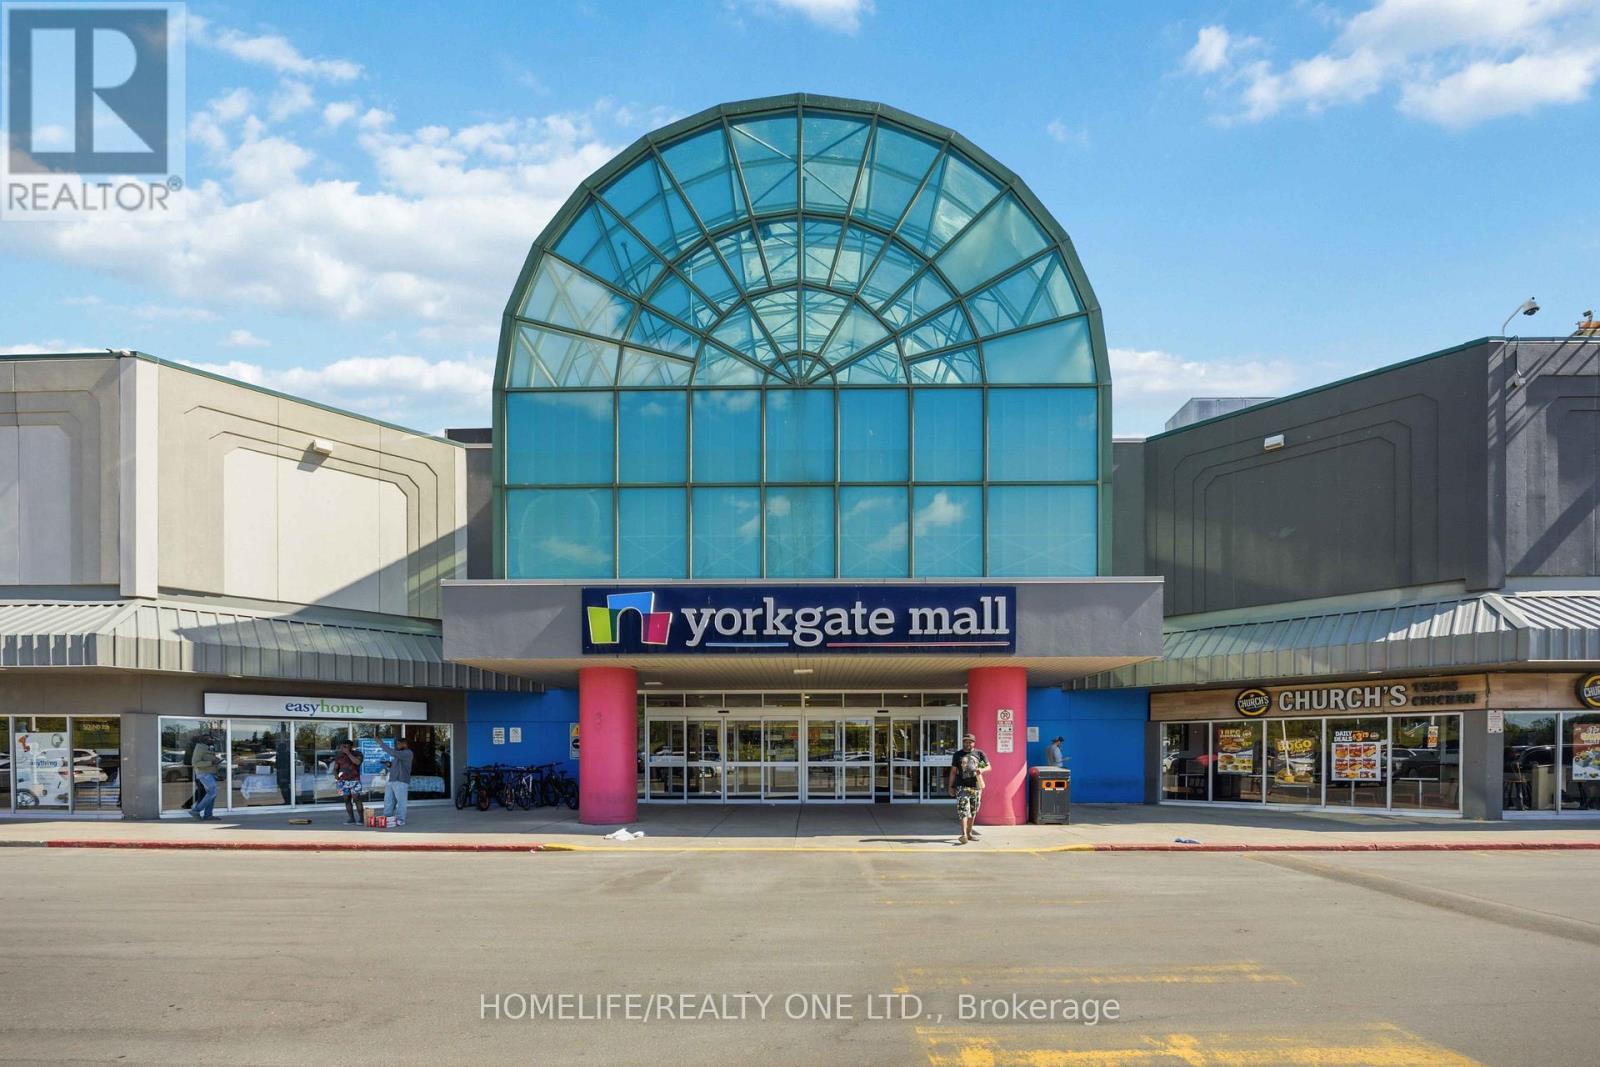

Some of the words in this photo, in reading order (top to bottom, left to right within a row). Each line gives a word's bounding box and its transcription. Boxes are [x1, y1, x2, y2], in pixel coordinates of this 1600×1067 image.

[681, 597, 895, 647] yorkgate
[908, 596, 1010, 635] mall
[1237, 695, 1270, 710] CHURCH'S
[1280, 684, 1407, 711] CHURCH'S
[285, 699, 364, 717] easyhome
[1277, 739, 1312, 752] BOGO
